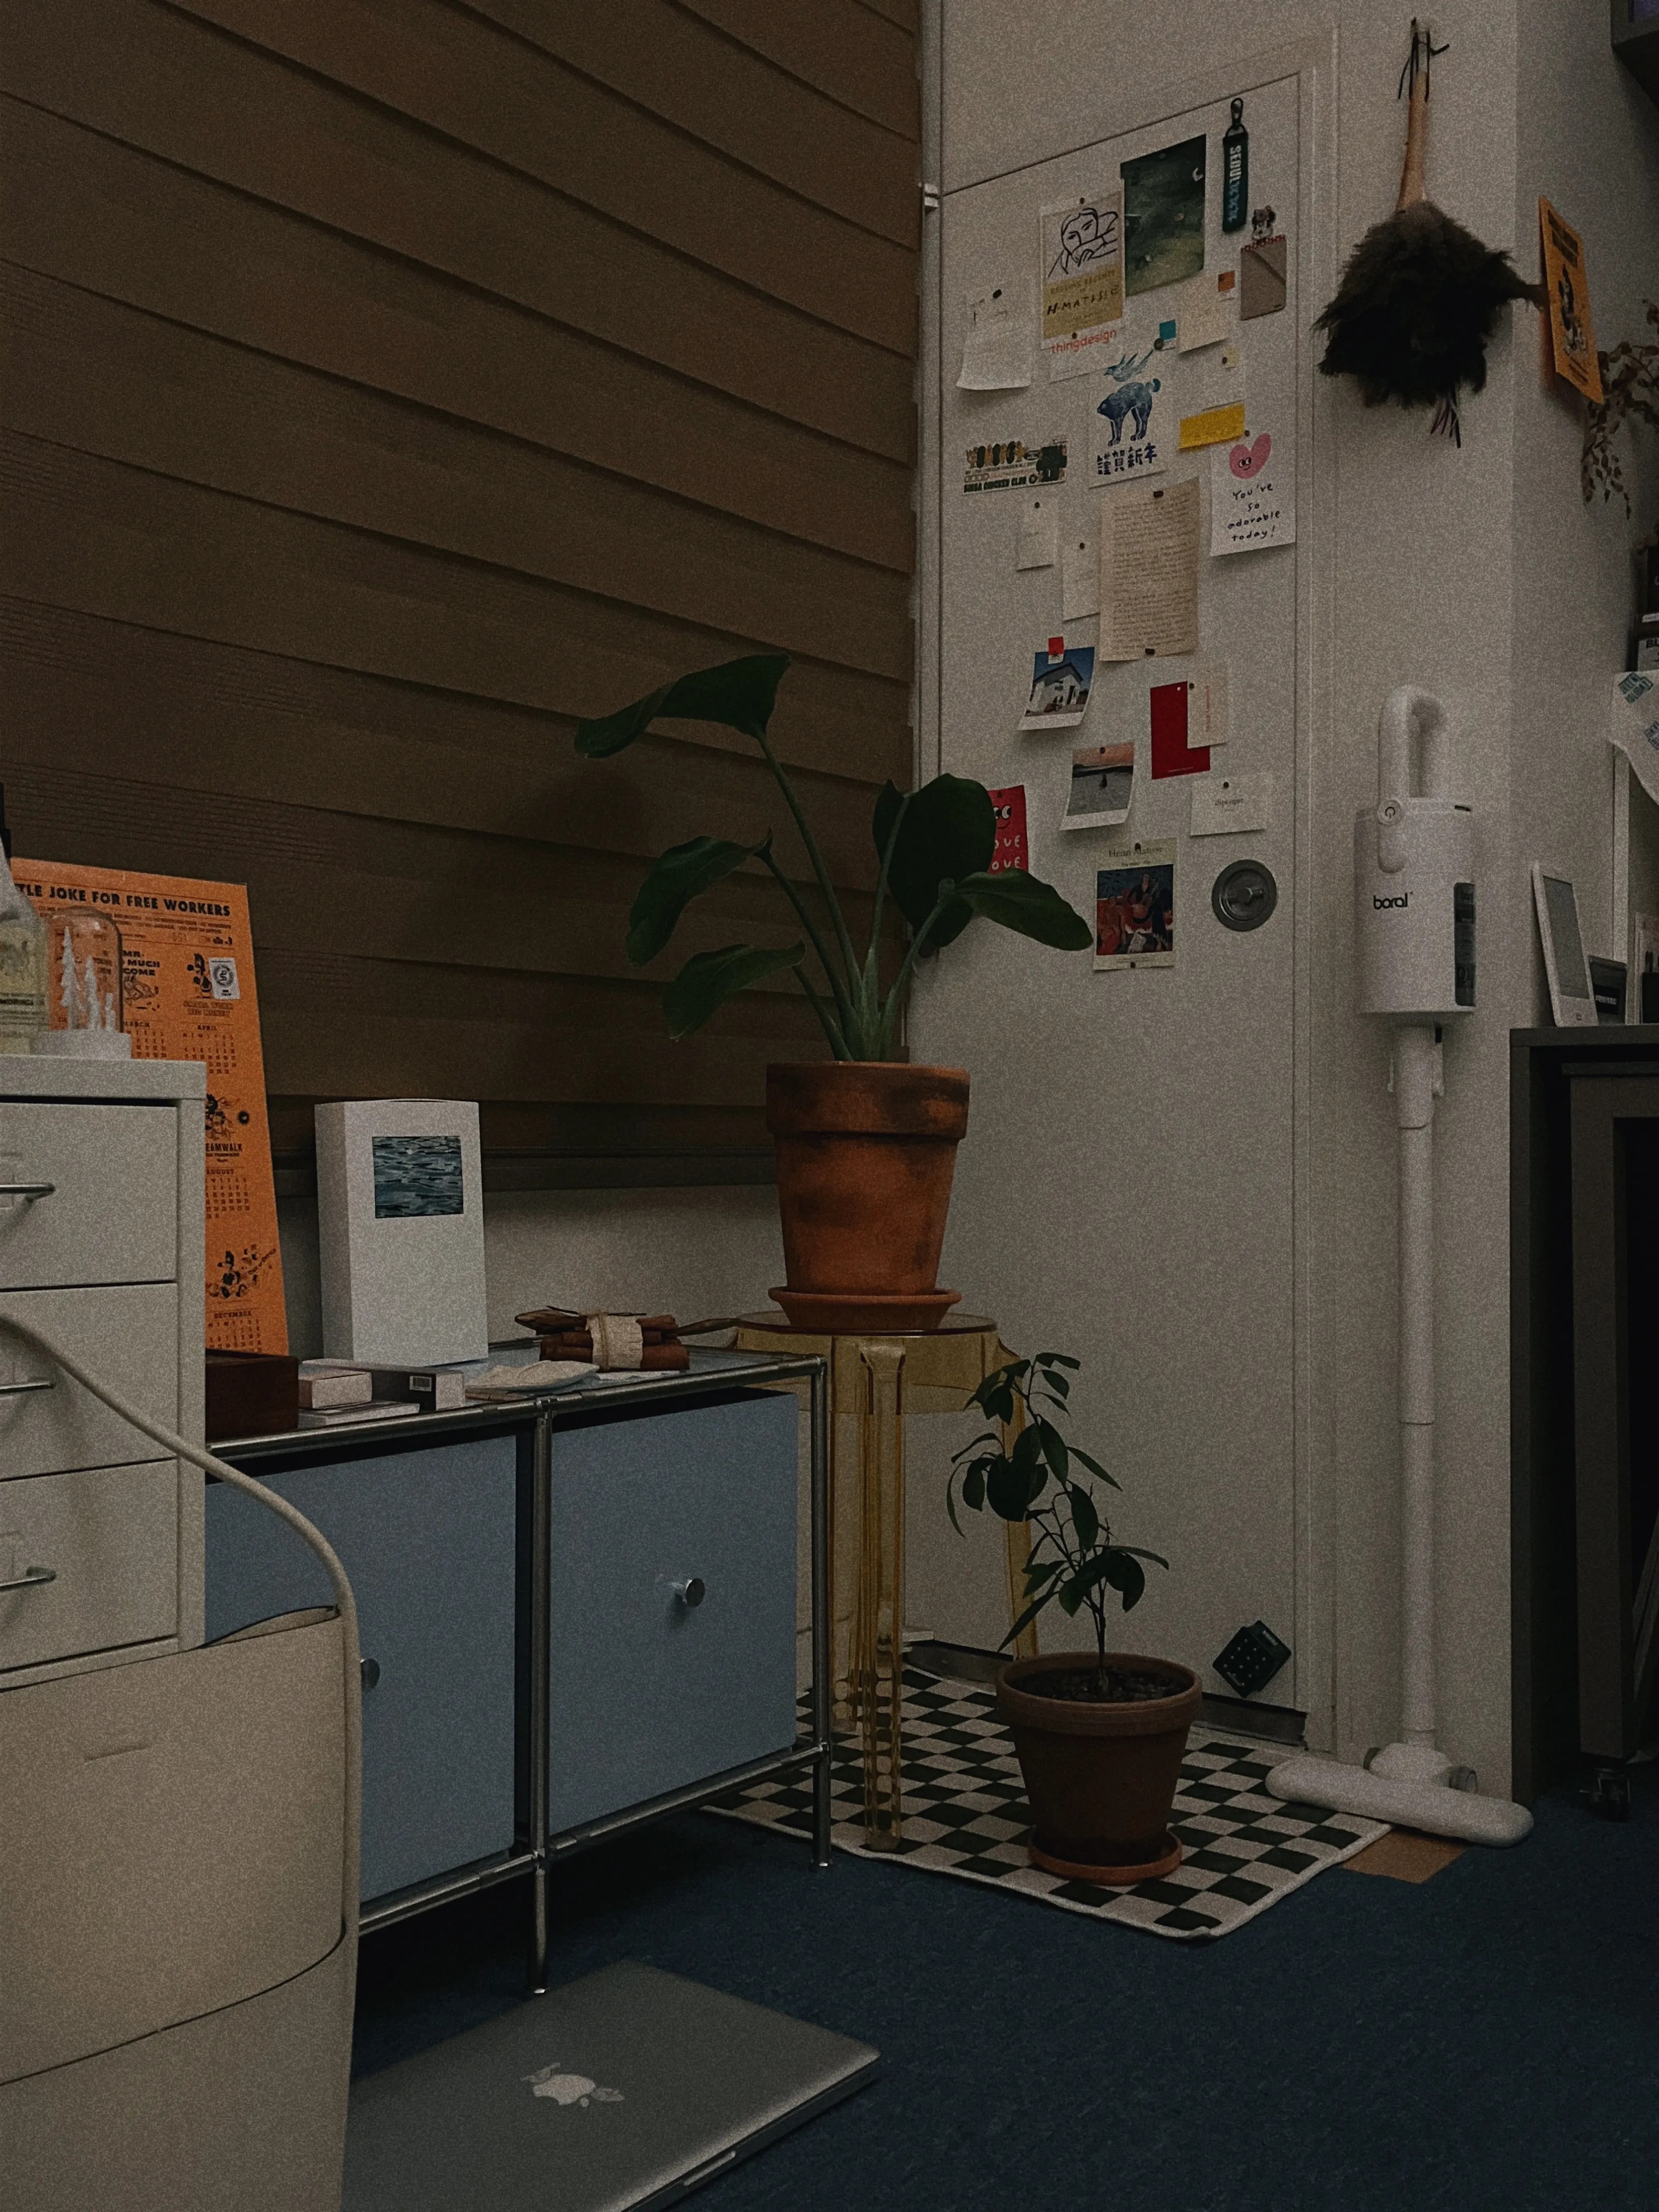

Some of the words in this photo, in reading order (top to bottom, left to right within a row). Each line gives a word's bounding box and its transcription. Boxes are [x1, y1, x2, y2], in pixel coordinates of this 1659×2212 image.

[1229, 145, 1242, 184] SEOUL
[1052, 329, 1117, 353] thingdesign
[1097, 442, 1157, 475] 謹賀新年
[1233, 483, 1273, 500] You've
[1248, 503, 1260, 512] so
[1228, 511, 1280, 529] adorable
[1232, 526, 1276, 542] today!
[992, 856, 1020, 871] OVE
[14, 883, 42, 897] TLE
[49, 887, 86, 901] JOKE
[92, 891, 121, 905] FOR
[126, 895, 158, 909] FREE
[163, 899, 230, 917] WORKERS
[1373, 892, 1408, 910] boral
[206, 1143, 242, 1152] EAMWALK
